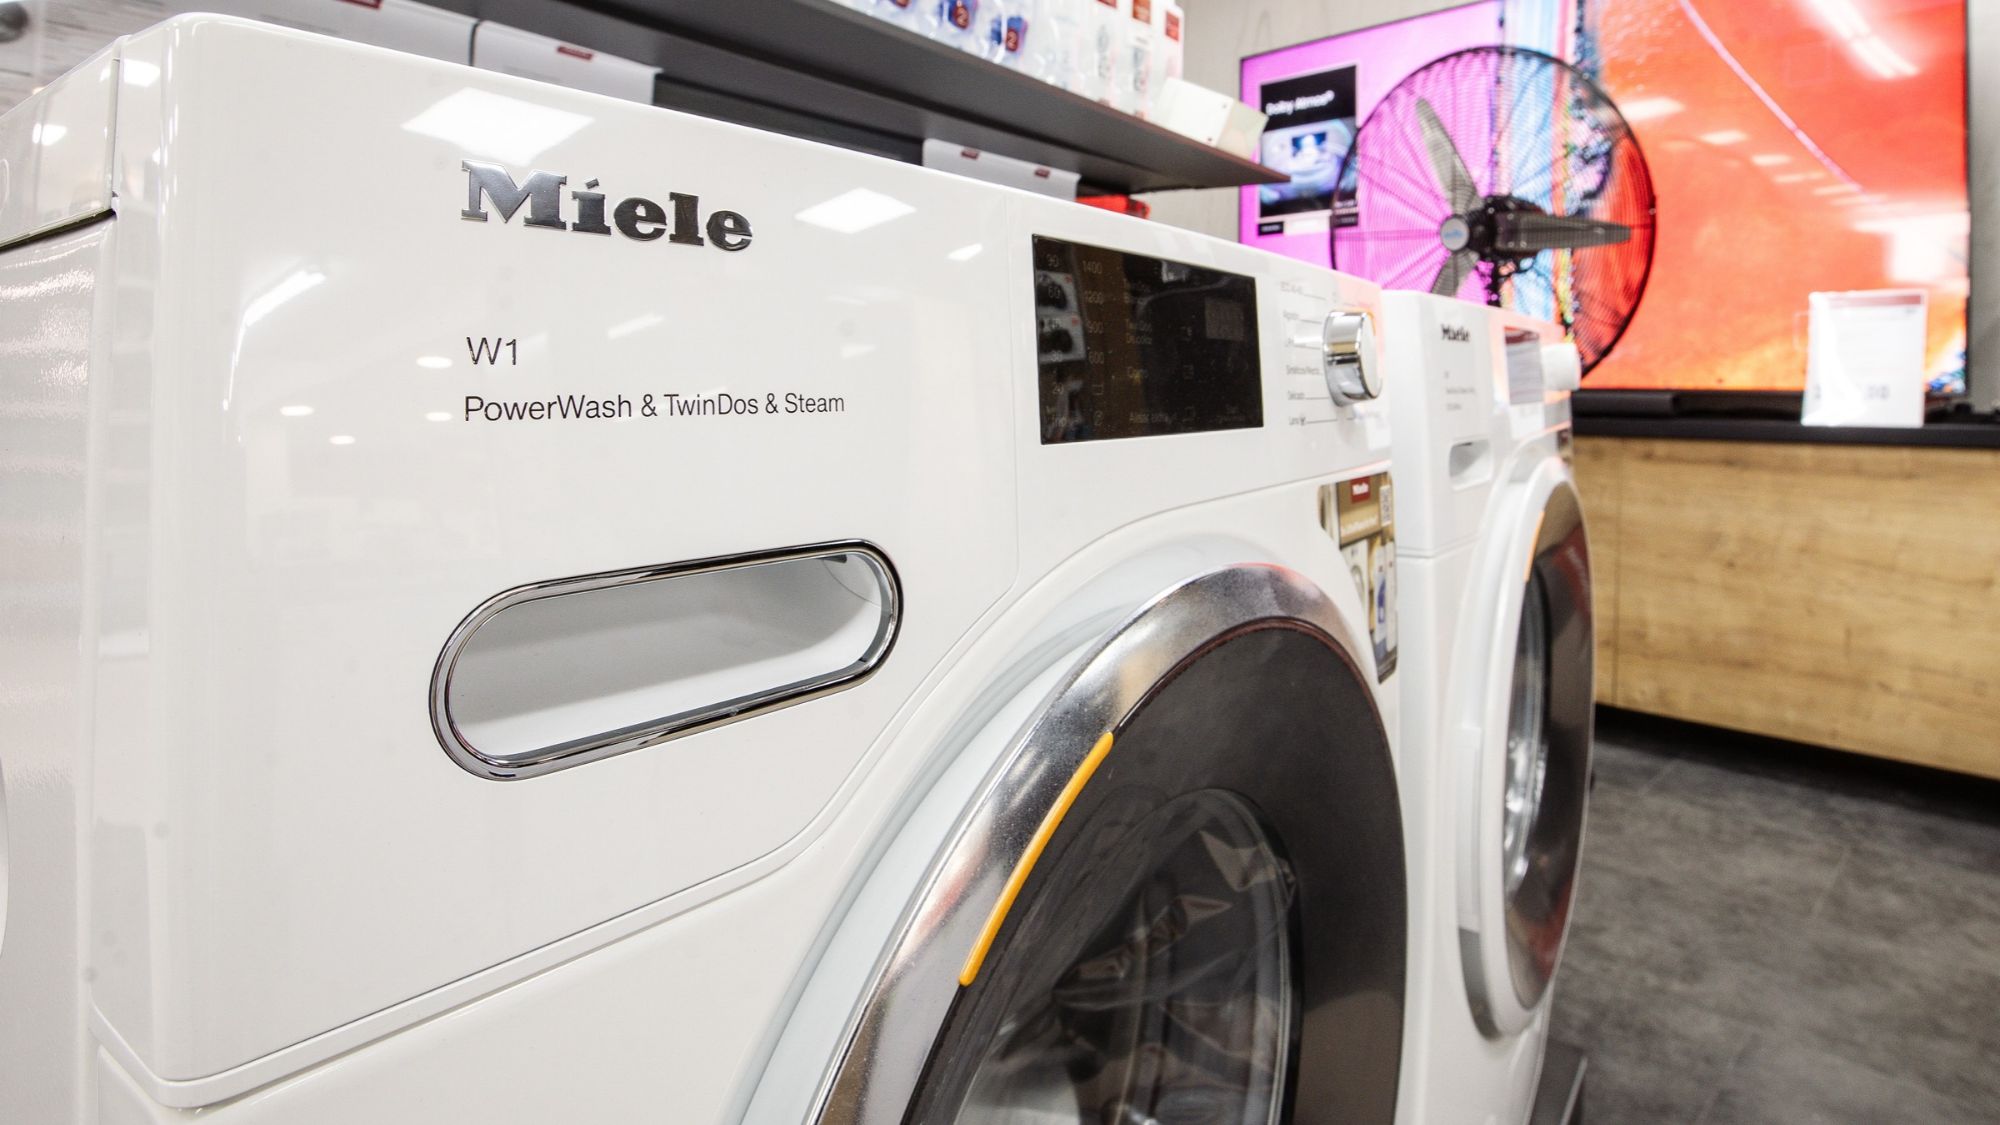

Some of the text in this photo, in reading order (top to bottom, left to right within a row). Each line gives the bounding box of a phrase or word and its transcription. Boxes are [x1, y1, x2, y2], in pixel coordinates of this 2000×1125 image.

[462, 162, 752, 251] Miele
[467, 337, 516, 365] W1
[466, 393, 844, 421] PowerWash & TwinDos & Steam
